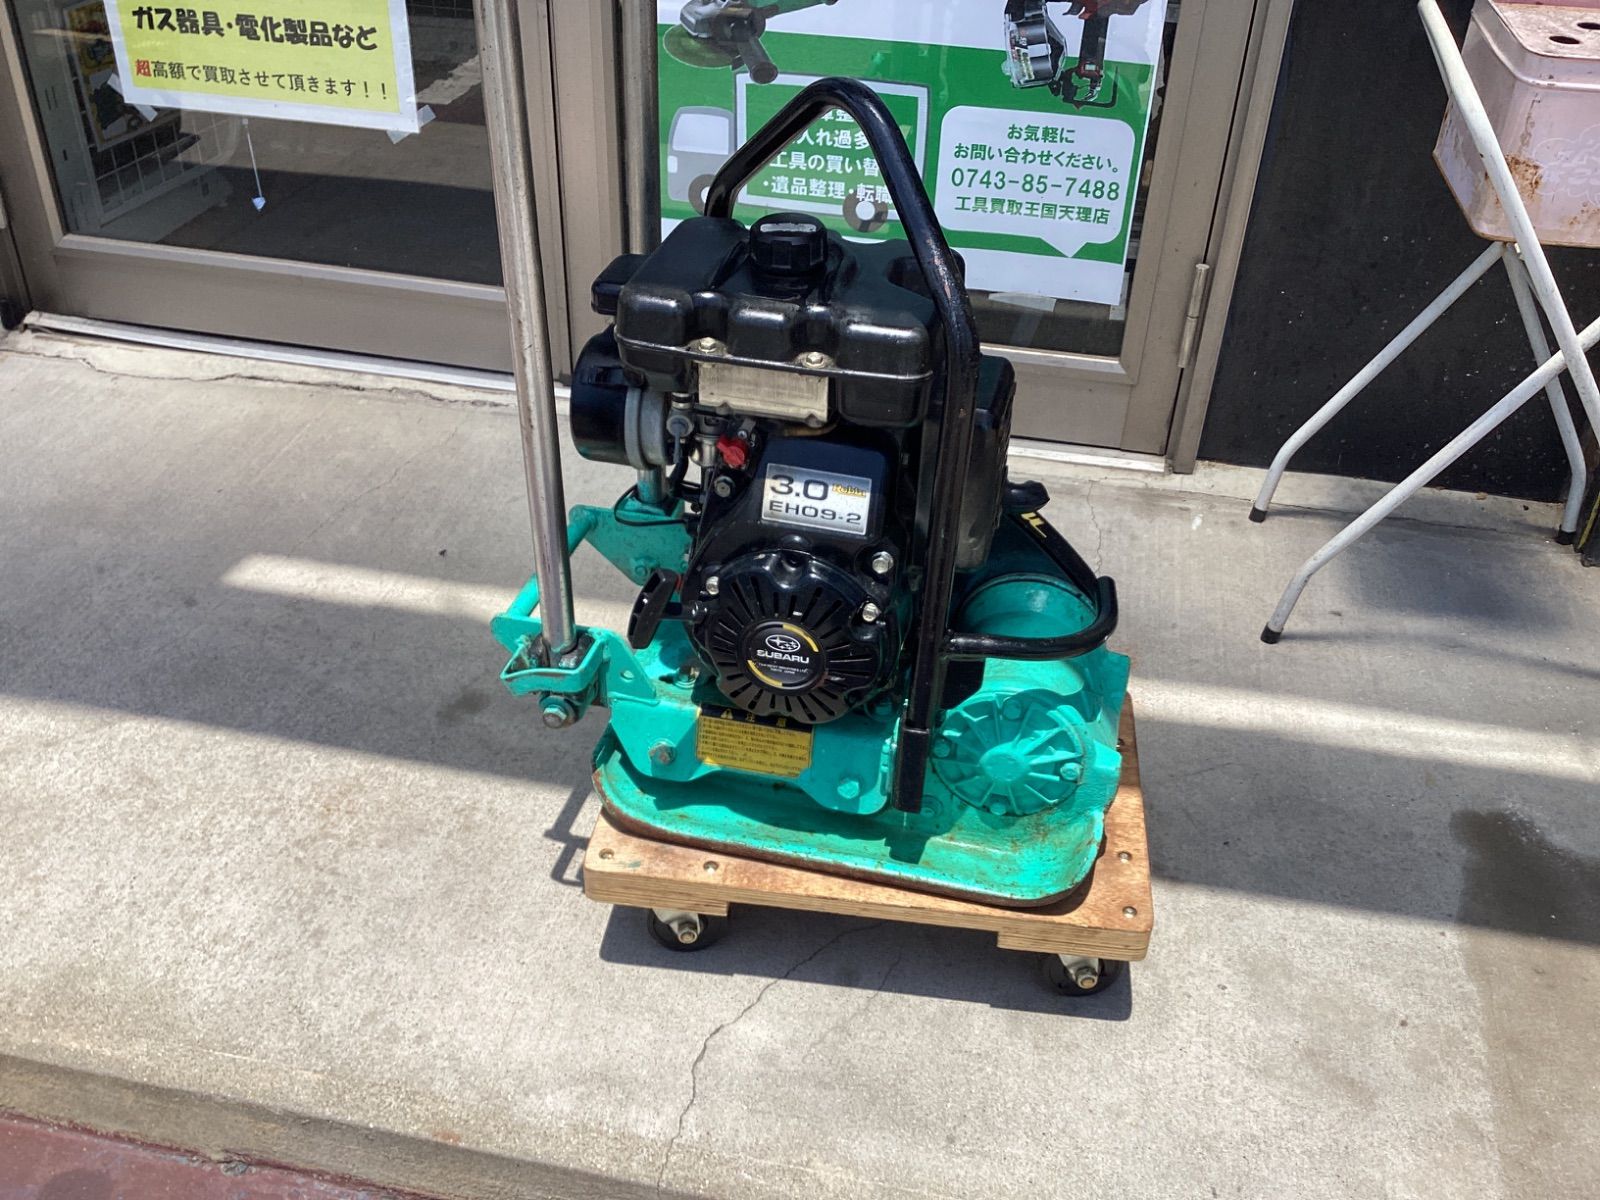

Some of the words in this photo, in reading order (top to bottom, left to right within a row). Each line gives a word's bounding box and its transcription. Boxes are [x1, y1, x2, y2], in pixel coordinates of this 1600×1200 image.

[132, 6, 378, 50] ガス器具・電化製品など
[135, 58, 388, 100] 超高額で買取させて頂きます！！
[793, 127, 870, 150] 入れ過多
[1007, 124, 1076, 144] お気軽に
[953, 143, 1118, 173] お問い合わせください。
[952, 167, 1120, 201] 0743-85-7488
[954, 196, 1110, 225] 工具買取王国天理店
[770, 474, 829, 501] 3.0
[769, 500, 862, 526] EH09-2
[756, 649, 810, 664] SUBARU
